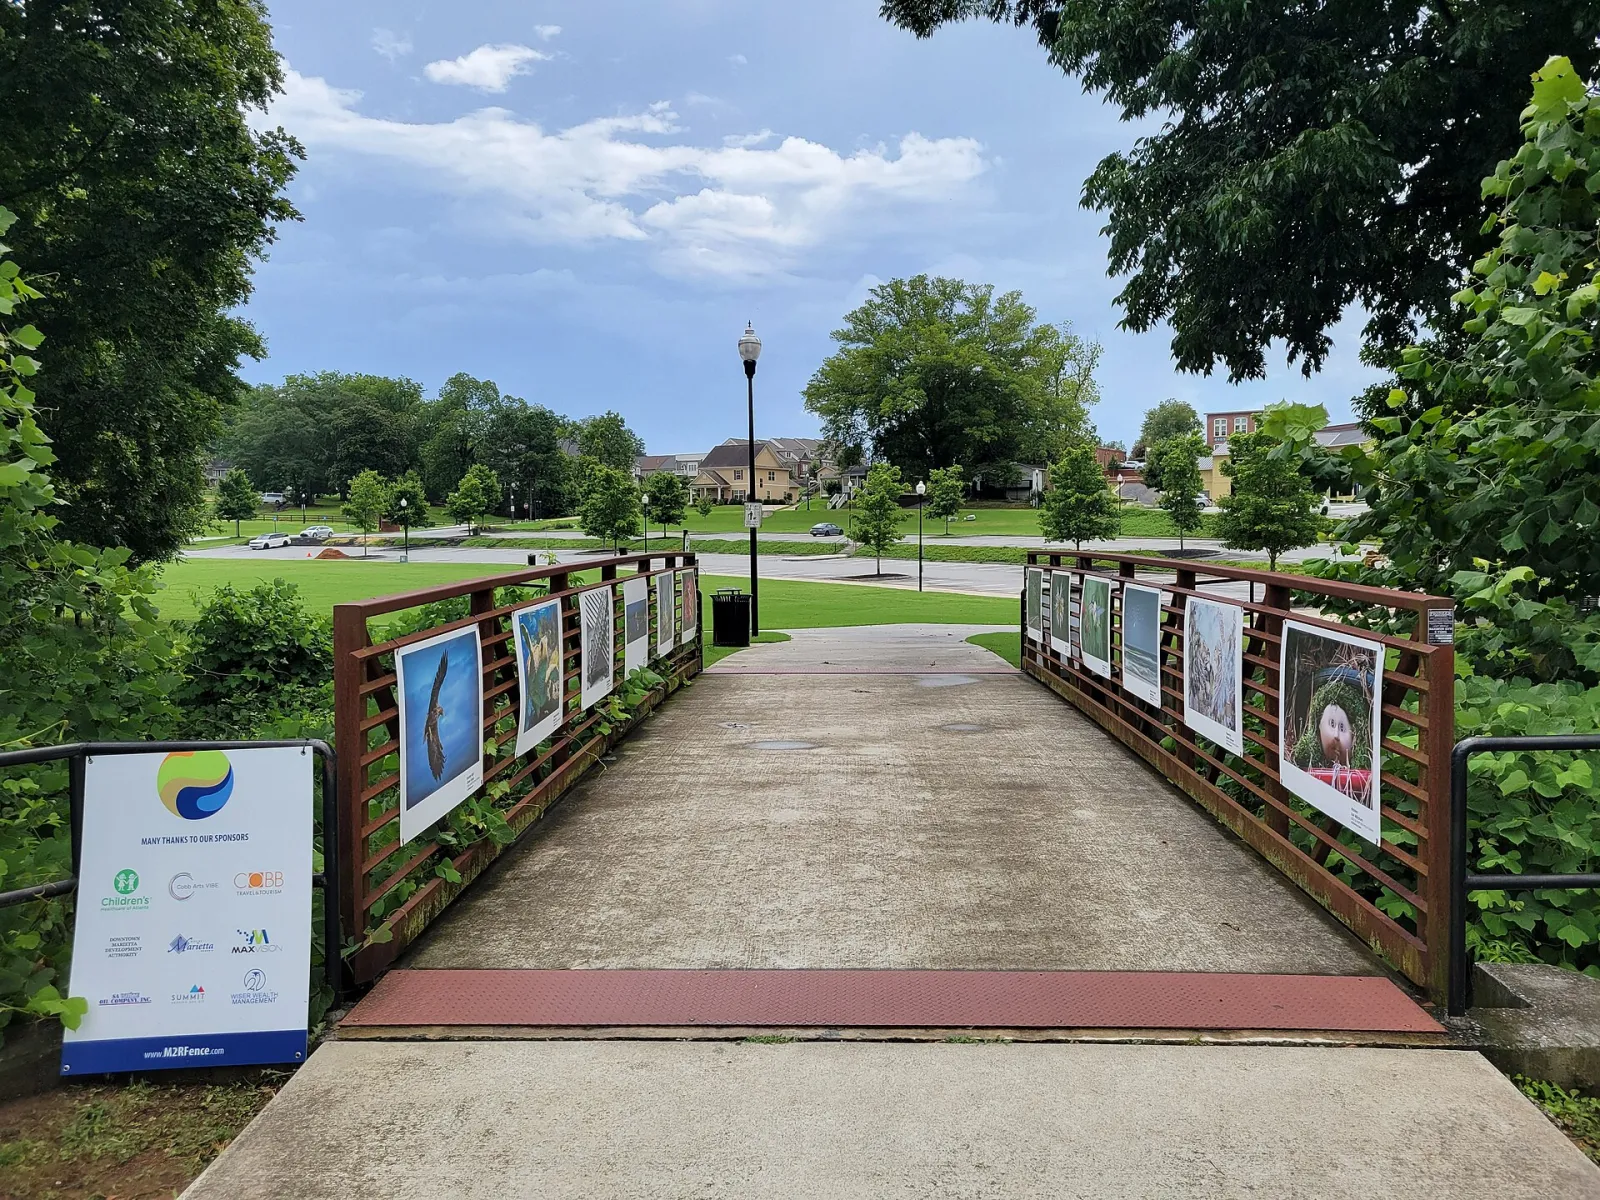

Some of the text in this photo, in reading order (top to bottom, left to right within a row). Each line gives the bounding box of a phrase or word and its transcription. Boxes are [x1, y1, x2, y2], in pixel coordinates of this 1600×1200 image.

[141, 832, 249, 845] MANY THANKS TO OUR SPONSORS
[233, 871, 284, 889] COBB
[101, 896, 149, 907] Children's
[231, 997, 277, 1005] MANAGEMENT
[144, 1046, 225, 1059] www.M2RFence.com
